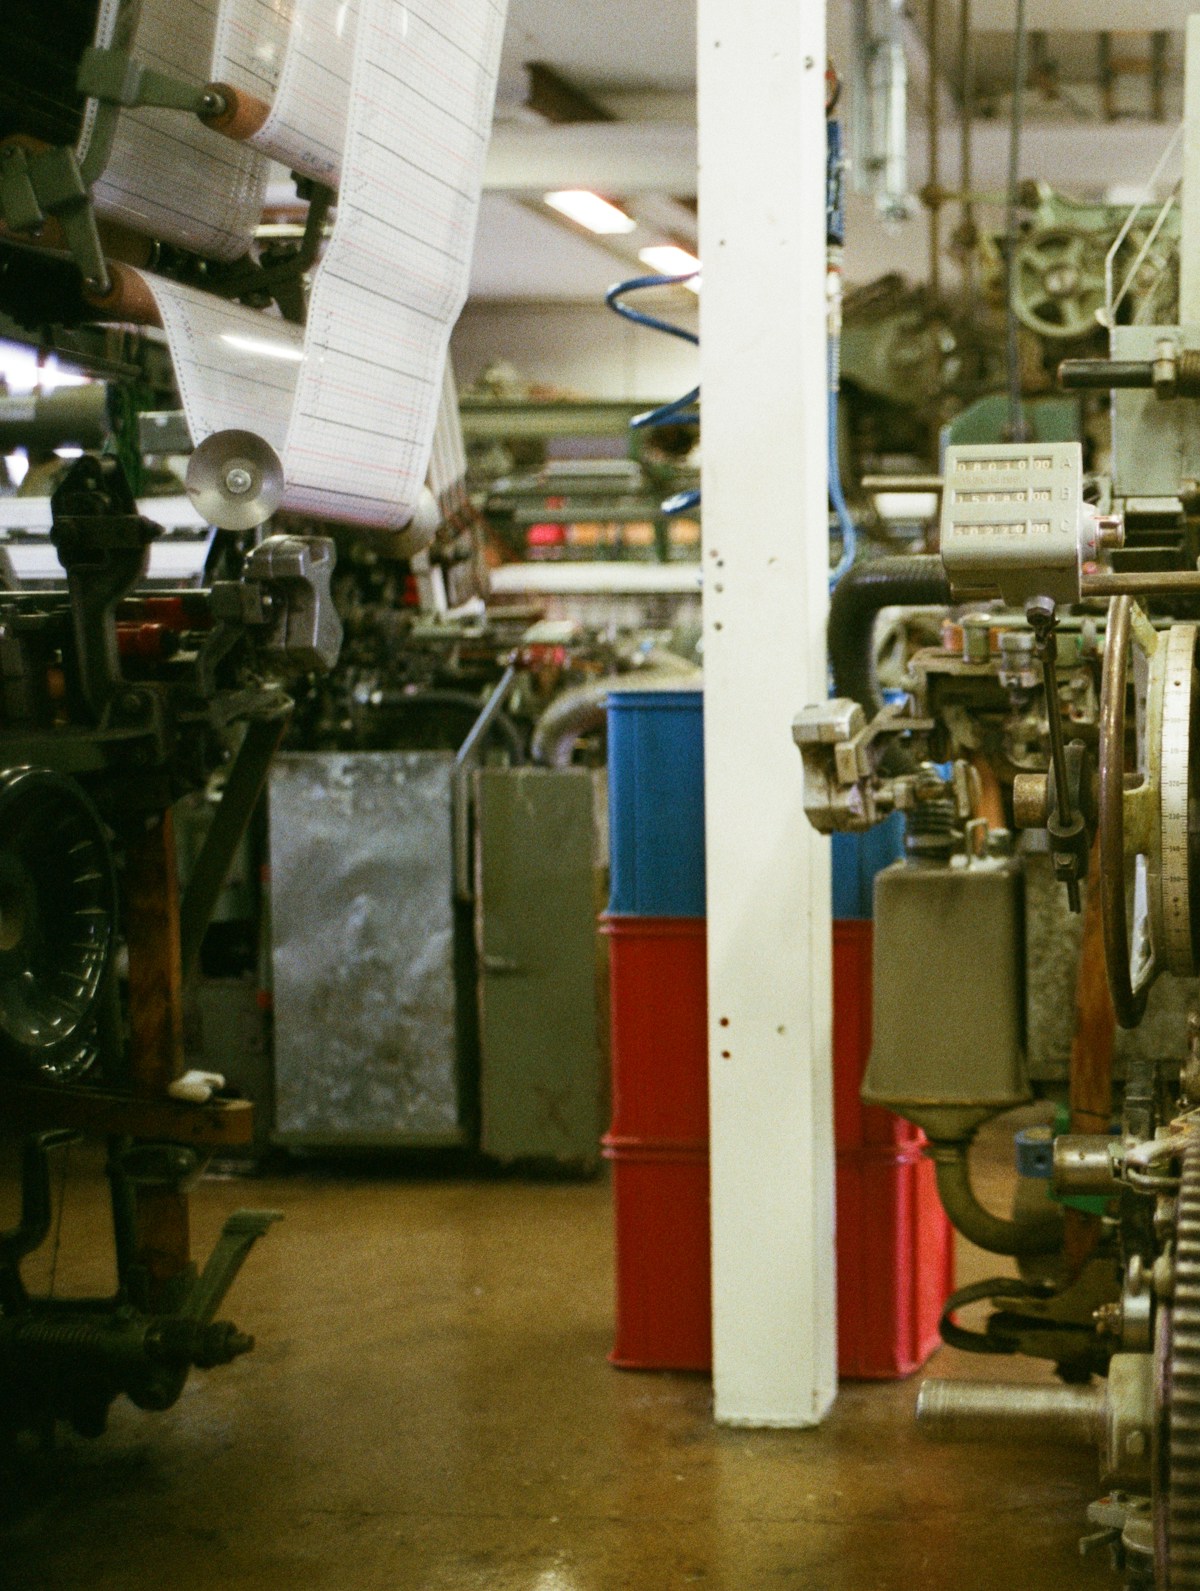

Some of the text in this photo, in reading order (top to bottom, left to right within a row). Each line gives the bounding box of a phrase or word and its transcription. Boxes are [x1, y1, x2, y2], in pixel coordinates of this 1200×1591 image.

[1061, 458, 1072, 469] A
[1060, 487, 1071, 501] B
[1060, 520, 1071, 533] C
